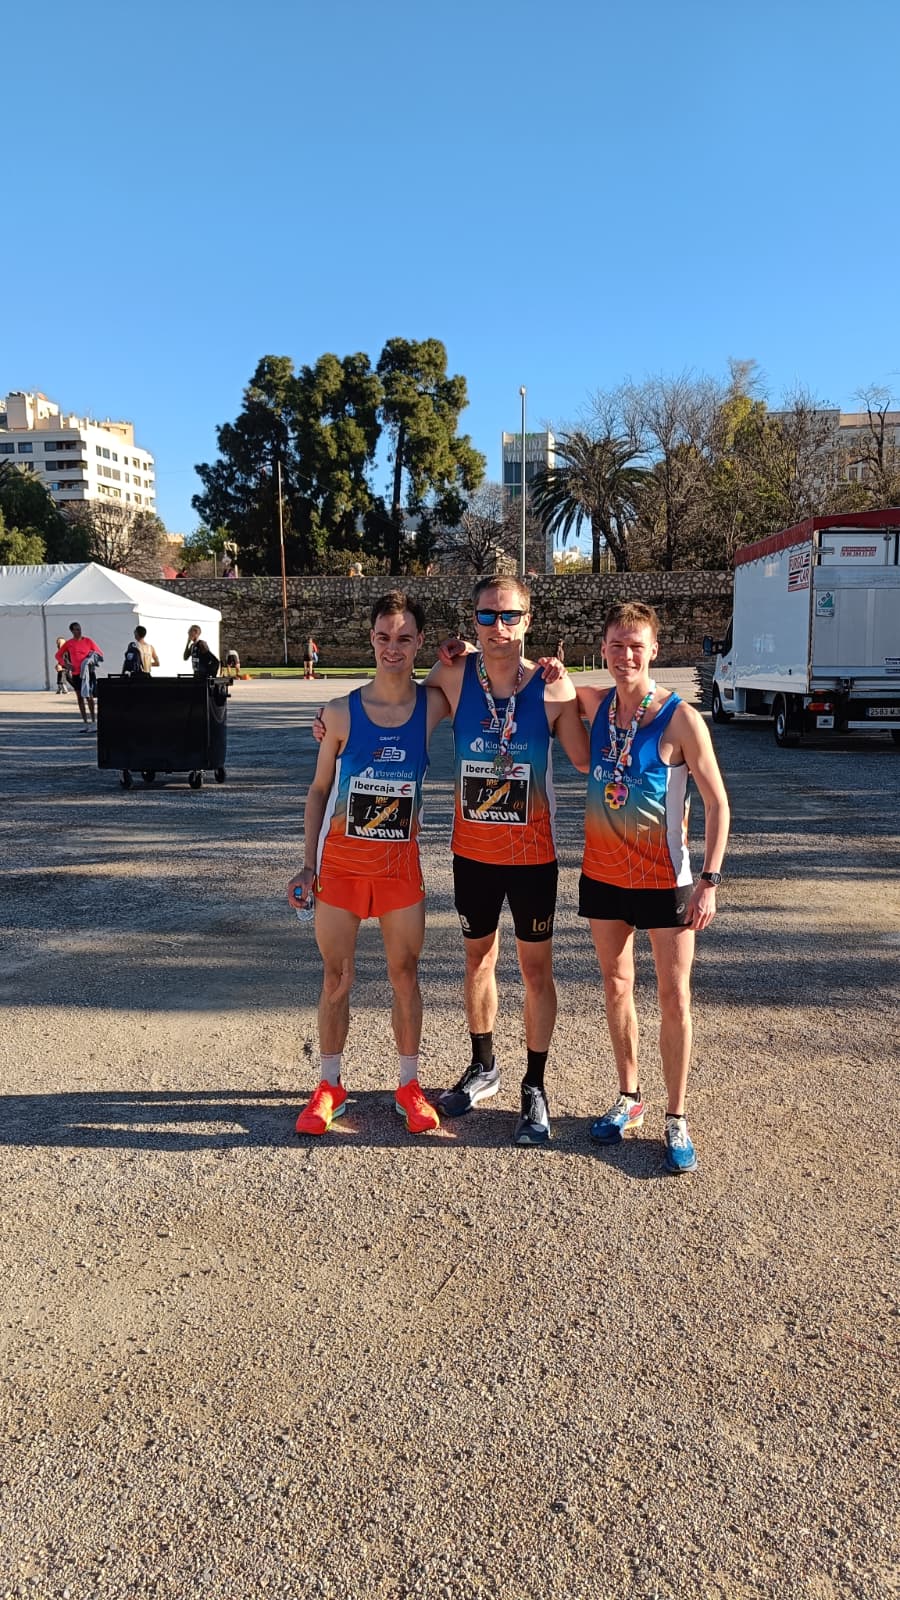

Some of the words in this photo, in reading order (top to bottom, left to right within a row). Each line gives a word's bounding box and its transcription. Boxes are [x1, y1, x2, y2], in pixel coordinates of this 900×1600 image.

[508, 440, 542, 450] PISINA
[507, 451, 544, 463] VALNCIA
[354, 781, 395, 793] Ibercaja
[364, 804, 399, 822] 1583
[468, 808, 520, 821] KIPRUN
[354, 826, 405, 838] KIPRUN
